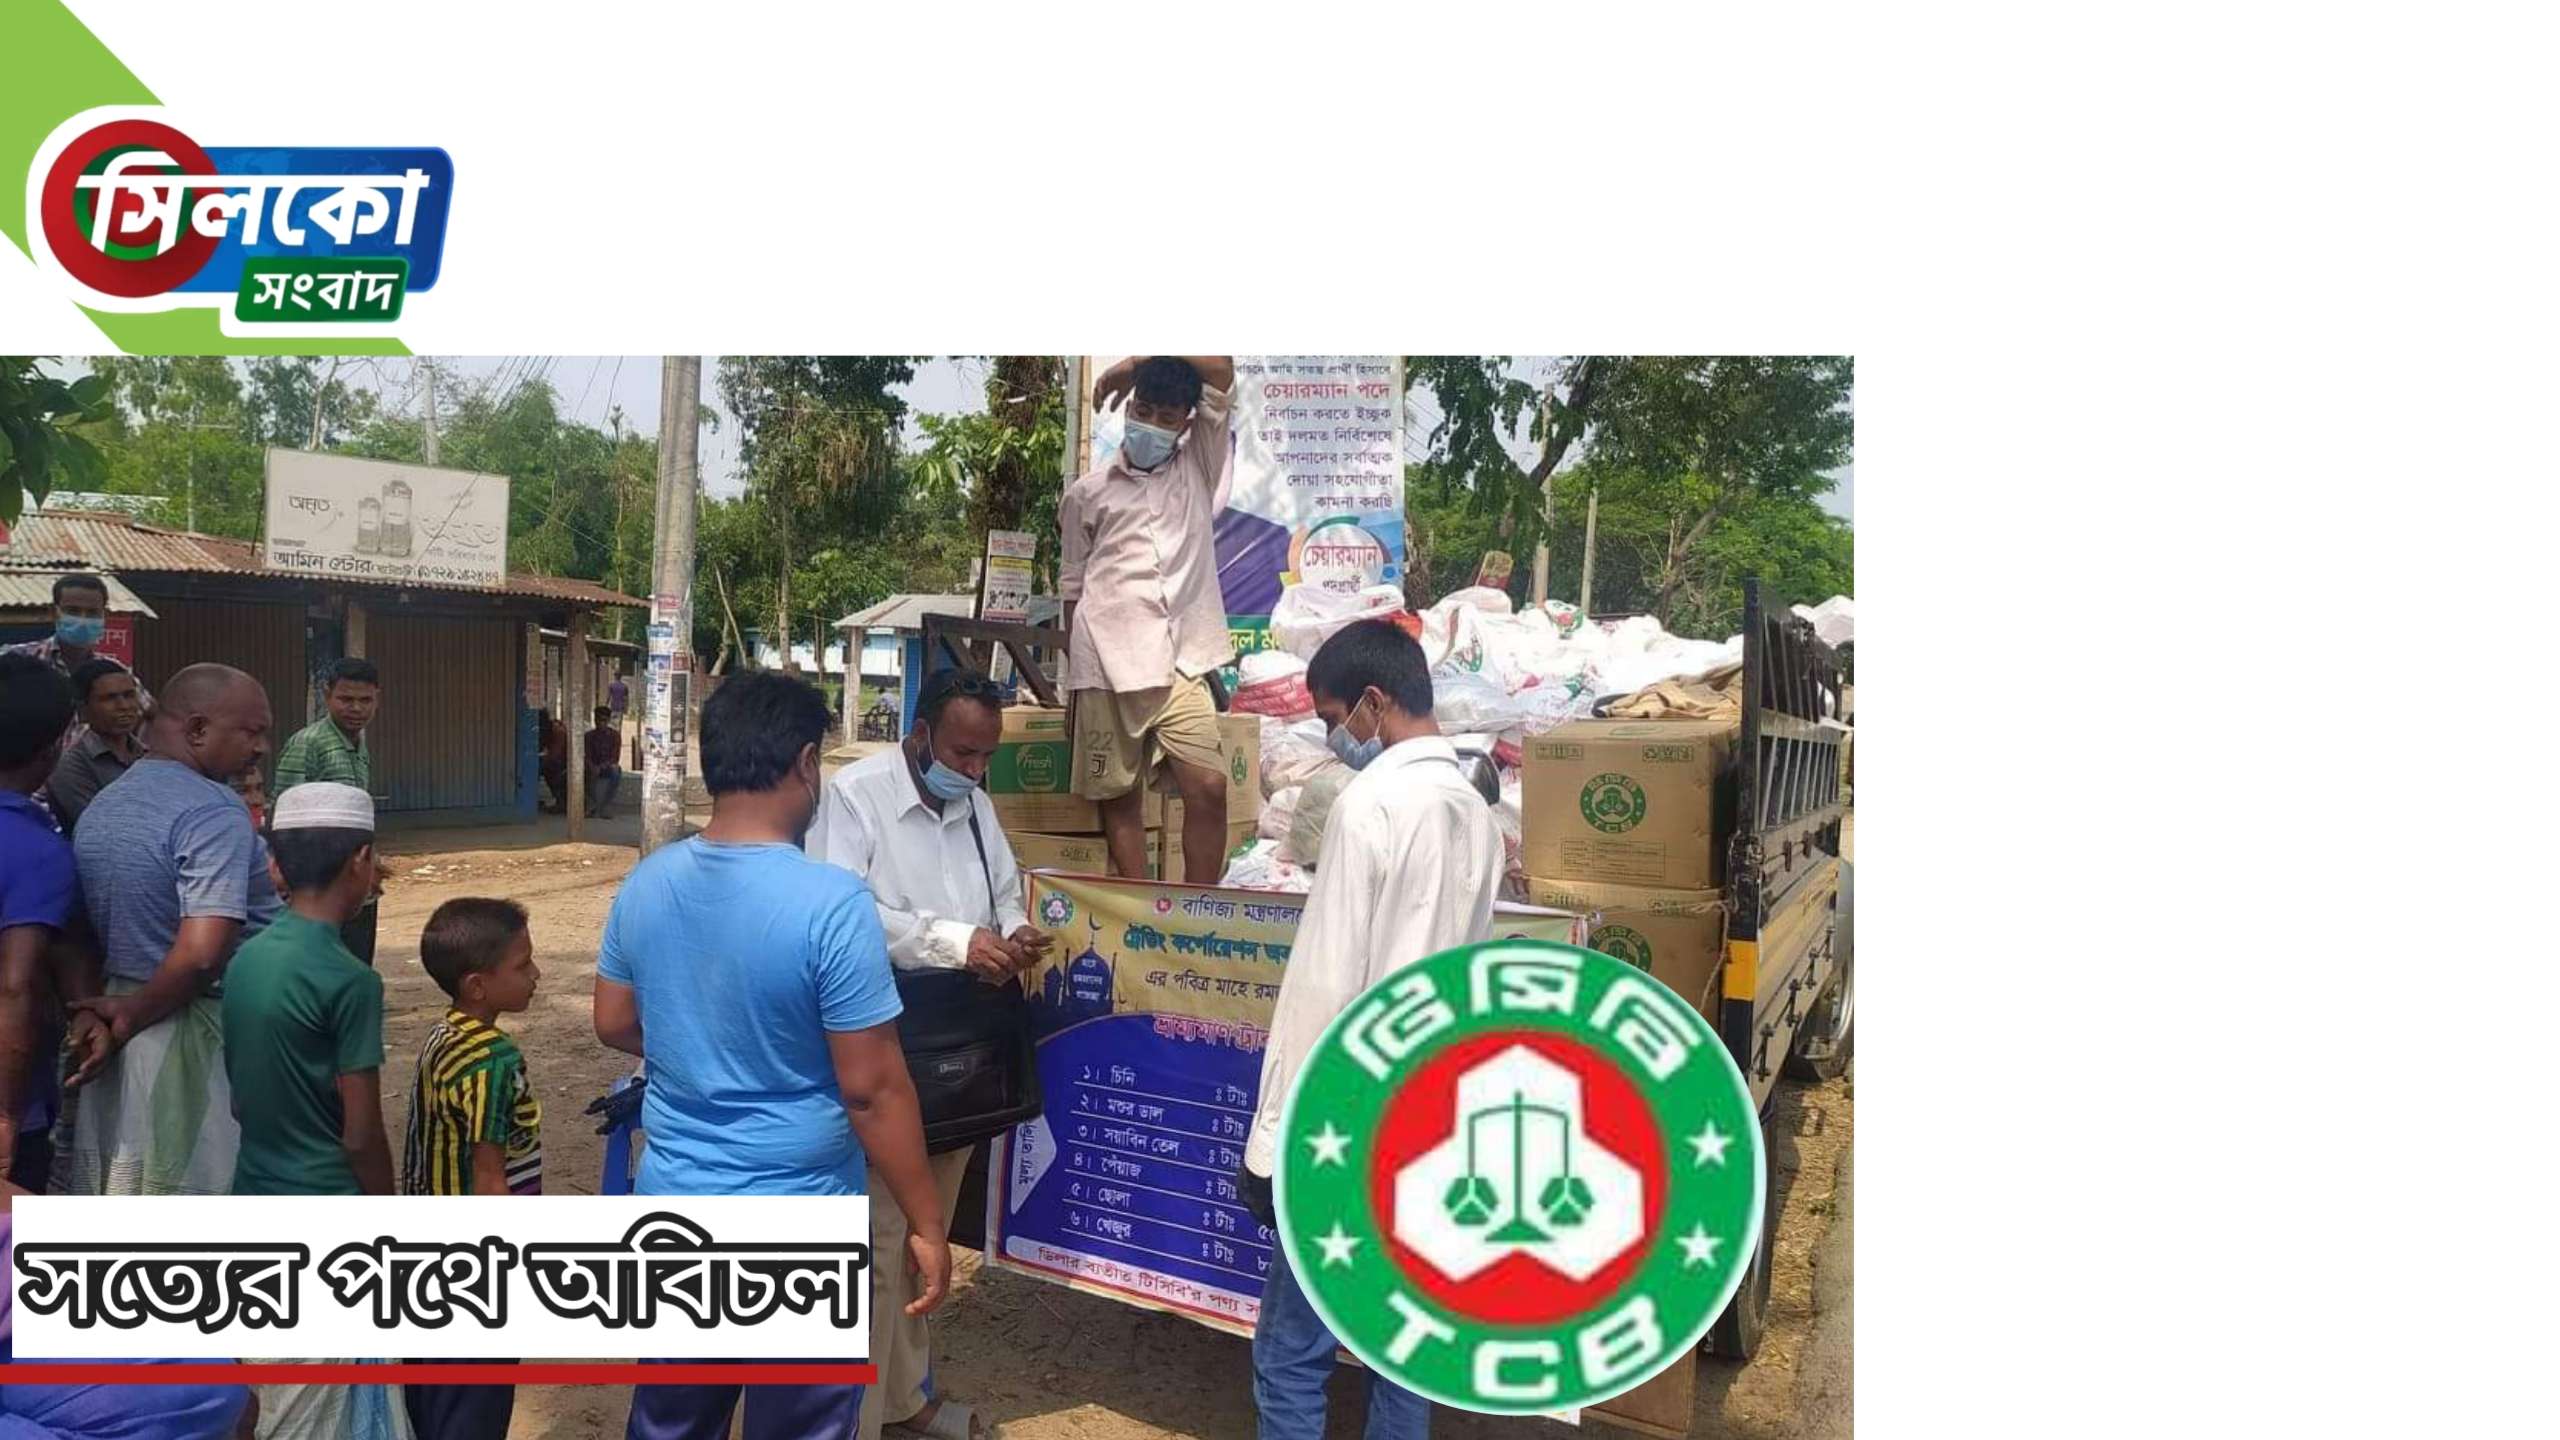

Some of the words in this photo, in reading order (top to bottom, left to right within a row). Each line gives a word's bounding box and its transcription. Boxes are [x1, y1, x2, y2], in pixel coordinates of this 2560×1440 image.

[1264, 383, 1348, 400] চেয়ারম্যান
[1357, 383, 1391, 400] পদে
[1264, 404, 1308, 421] নির্বাচন
[1312, 409, 1350, 420] করতে
[1257, 428, 1283, 442] তাই
[1274, 452, 1338, 465] আপনাদের
[1287, 474, 1319, 488] দোয়া
[1314, 496, 1353, 509] কামনা
[272, 548, 327, 571] আমিন
[1304, 545, 1378, 570] চেয়ারম্যান
[1181, 894, 1237, 921] বাণিজ্য
[1145, 970, 1168, 987] এর
[1173, 969, 1211, 994] পবিত্র
[1215, 976, 1250, 999] মাহে
[1111, 1065, 1137, 1087] চিনি
[1138, 1104, 1165, 1123] ডাল
[1104, 1128, 1148, 1150] সয়াবিন
[1151, 1138, 1179, 1157] তেল
[1096, 1218, 1132, 1241] খেজুর
[1257, 1256, 1273, 1272] ৮
[1038, 1246, 1081, 1270] ডিলার
